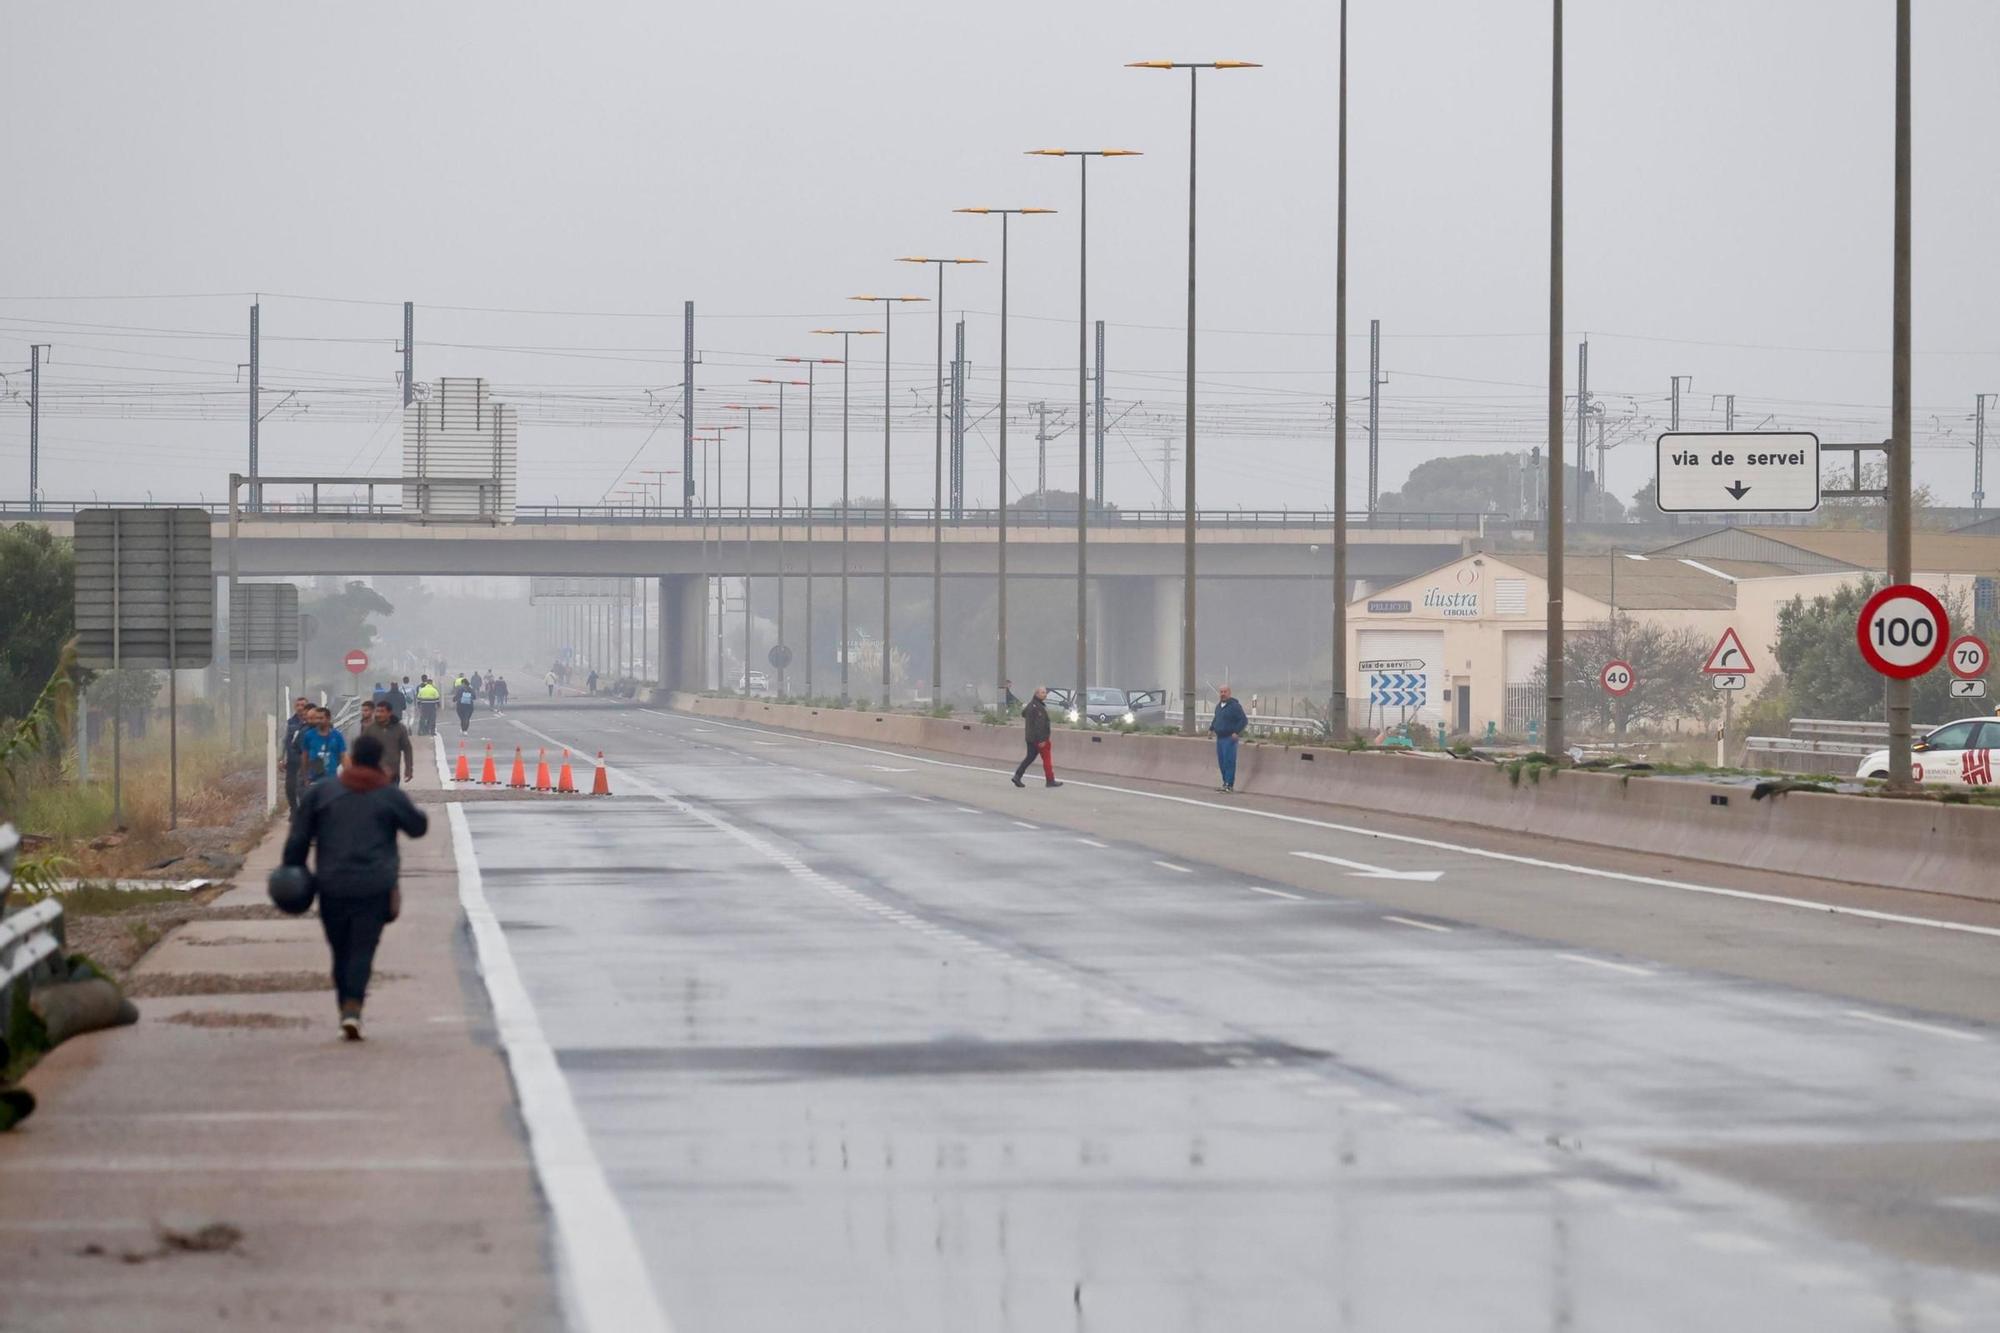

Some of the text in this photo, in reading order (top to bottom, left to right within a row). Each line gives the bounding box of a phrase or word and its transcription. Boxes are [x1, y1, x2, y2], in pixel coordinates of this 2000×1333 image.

[1672, 450, 1805, 466] via de servei
[1424, 587, 1477, 607] ilustra
[1874, 617, 1934, 647] 100
[1957, 650, 1980, 665] 70
[1607, 672, 1628, 684] 40
